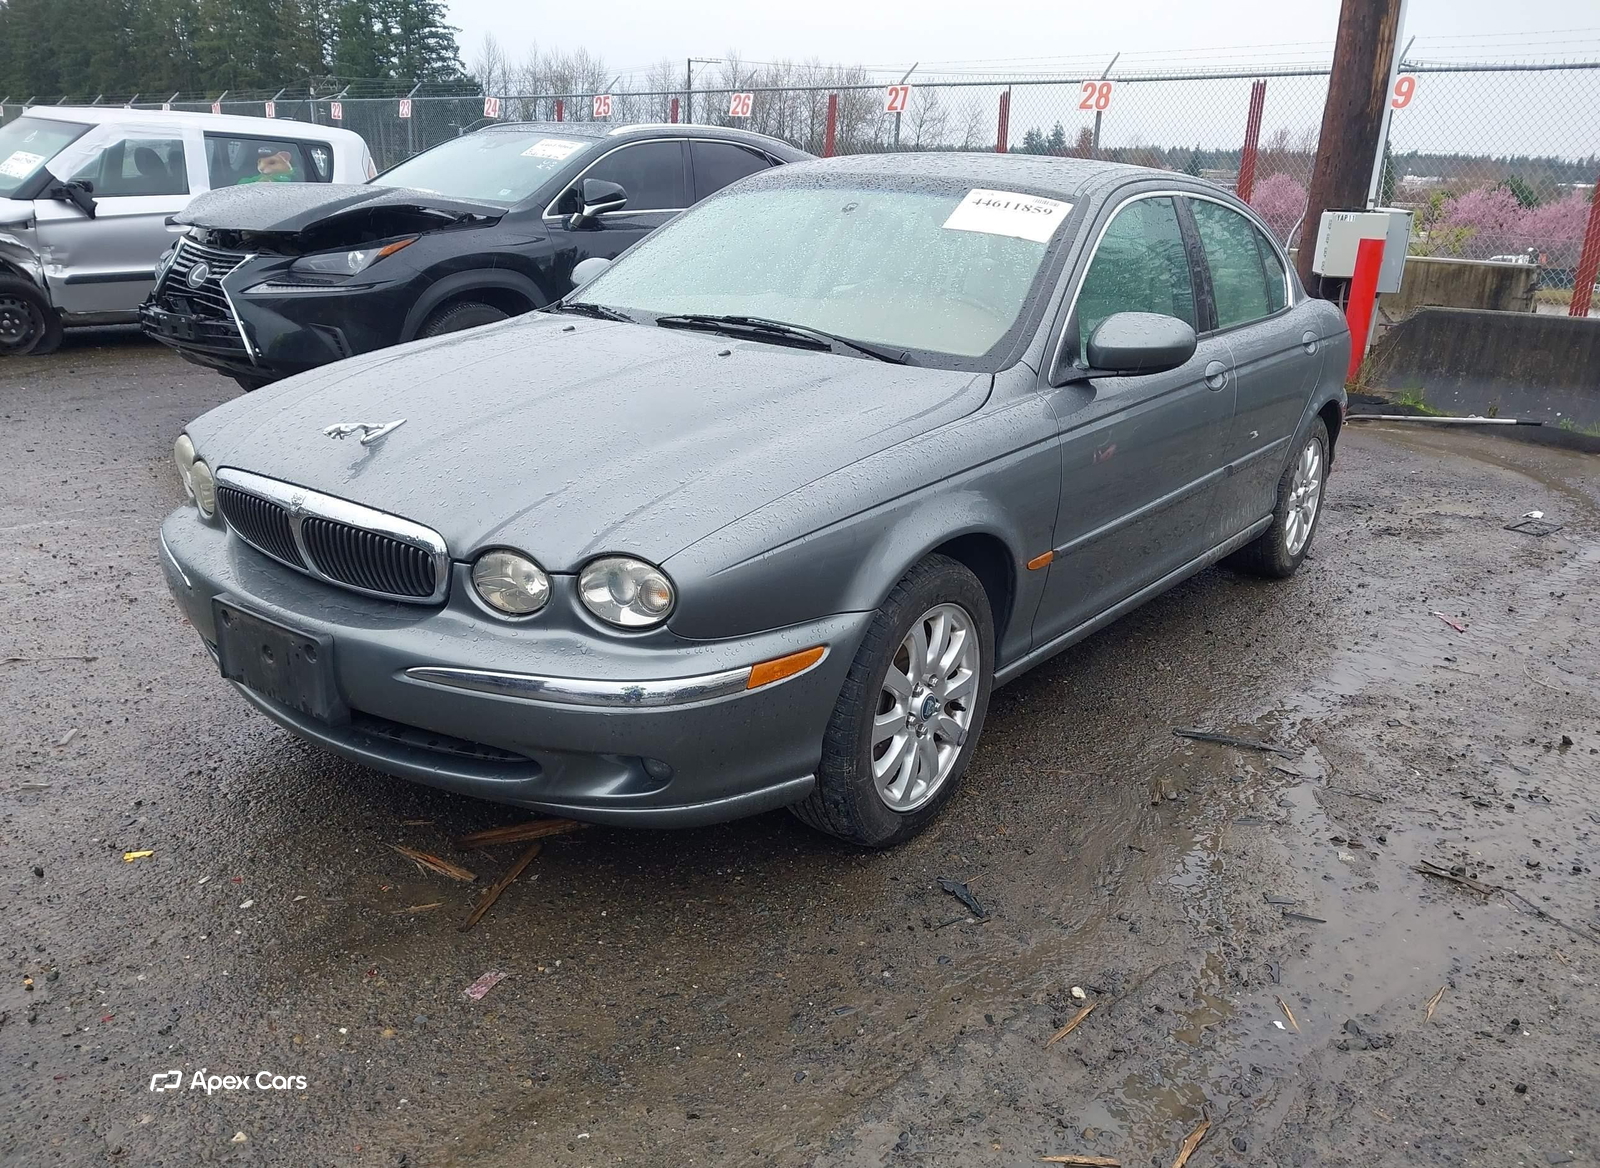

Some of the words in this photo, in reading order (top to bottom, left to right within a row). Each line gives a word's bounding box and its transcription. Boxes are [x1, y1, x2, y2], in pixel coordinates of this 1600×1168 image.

[731, 94, 751, 115] 26
[887, 86, 909, 111] 27
[1079, 82, 1112, 110] 28
[332, 102, 342, 118] 22
[400, 100, 411, 116] 23
[486, 98, 498, 116] 24
[595, 96, 611, 116] 25
[971, 197, 1053, 216] 44611859
